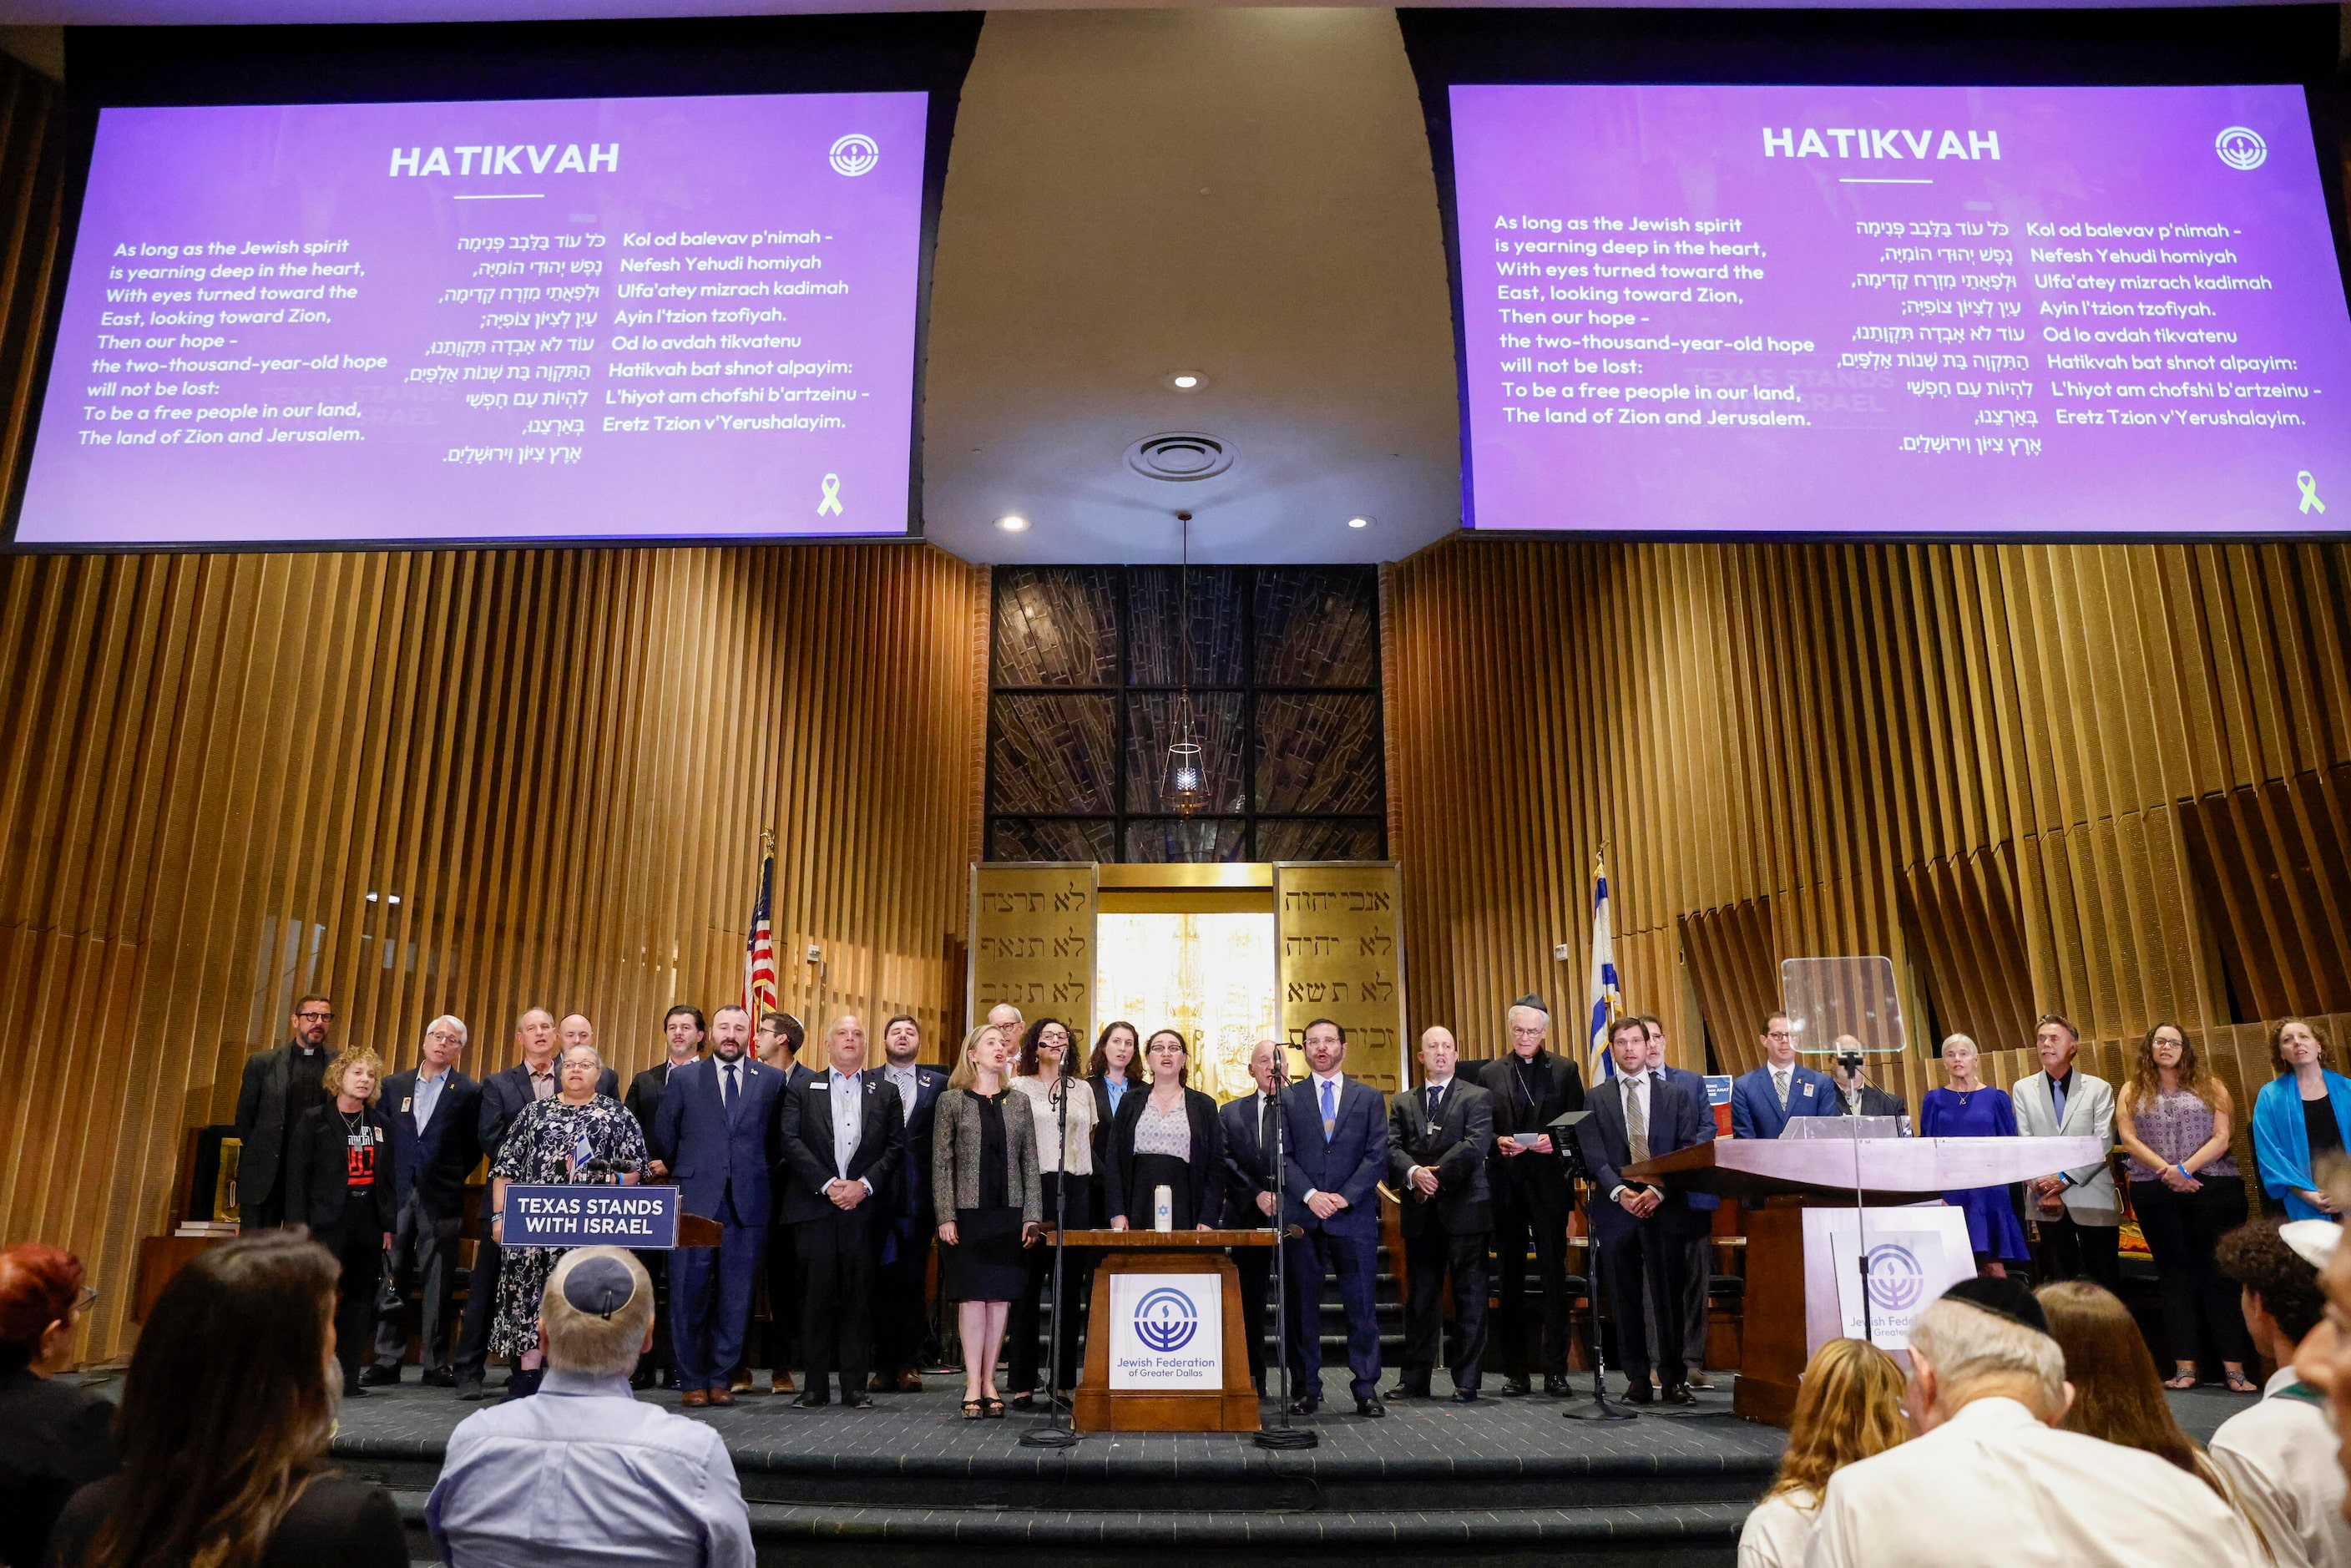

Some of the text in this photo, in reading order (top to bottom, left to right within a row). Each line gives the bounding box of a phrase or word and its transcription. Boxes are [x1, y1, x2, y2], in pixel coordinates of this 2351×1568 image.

[1762, 127, 2000, 160] HATIKVAH
[389, 143, 619, 177] HATIKVAH
[1494, 215, 1742, 235] As long as the Jewish spirit
[113, 239, 350, 259] As long as the Jewish spirit
[1495, 238, 1767, 258] is yearning deep in the heart,
[2030, 247, 2237, 266] Nefesh Yehudi homiyah
[109, 261, 365, 282] is yearning deep in the heart,
[620, 254, 822, 272] Nefesh Yehudi homiyah
[1495, 261, 1764, 280] With eyes turned toward the
[617, 280, 849, 300] Ulfa'atey mizrach kadimah
[2034, 273, 2273, 292] Ulfa'atey mizrach kadimah
[106, 284, 358, 305] With eyes turned toward the
[1497, 285, 1743, 305] East, looking toward Zion,
[100, 308, 331, 327] East, looking toward Zion,
[614, 306, 786, 327] Ayin l'tzion tzofiyah.
[2040, 300, 2217, 319] Ayin l'tzion tzofiyah.
[611, 334, 801, 351] Od lo avdah tikvatenu
[2042, 326, 2237, 343] Od lo avdah tikvatenu
[91, 354, 387, 373] the two-thousand-year-old hope
[609, 359, 852, 377] Hatikvah bat shnot alpayim:
[2046, 353, 2298, 373] Hatikvah bat shnot alpayim:
[87, 381, 220, 397] will not be lost:
[83, 401, 361, 422] To be a free people in our land,
[2055, 408, 2306, 428] Eretz Tzion v'Yerushalayim.
[603, 413, 846, 432] Eretz Tzion v'Yerushalayim.
[78, 427, 365, 445] The land of Zion and Jerusalem.
[982, 881, 1085, 912] לא תרצח
[1286, 891, 1389, 912] אנכי יהוה
[980, 925, 1085, 962] לא תנאף
[1287, 925, 1392, 957] לא יהיה
[1053, 971, 1085, 1003] לא
[1287, 970, 1393, 1003] לא תשא
[518, 1197, 663, 1216] TEXAS STANDS
[525, 1216, 653, 1235] WITH ISRAEL
[1117, 1358, 1215, 1368] Jewish Federation
[1129, 1368, 1203, 1377] of Greater Dallas
